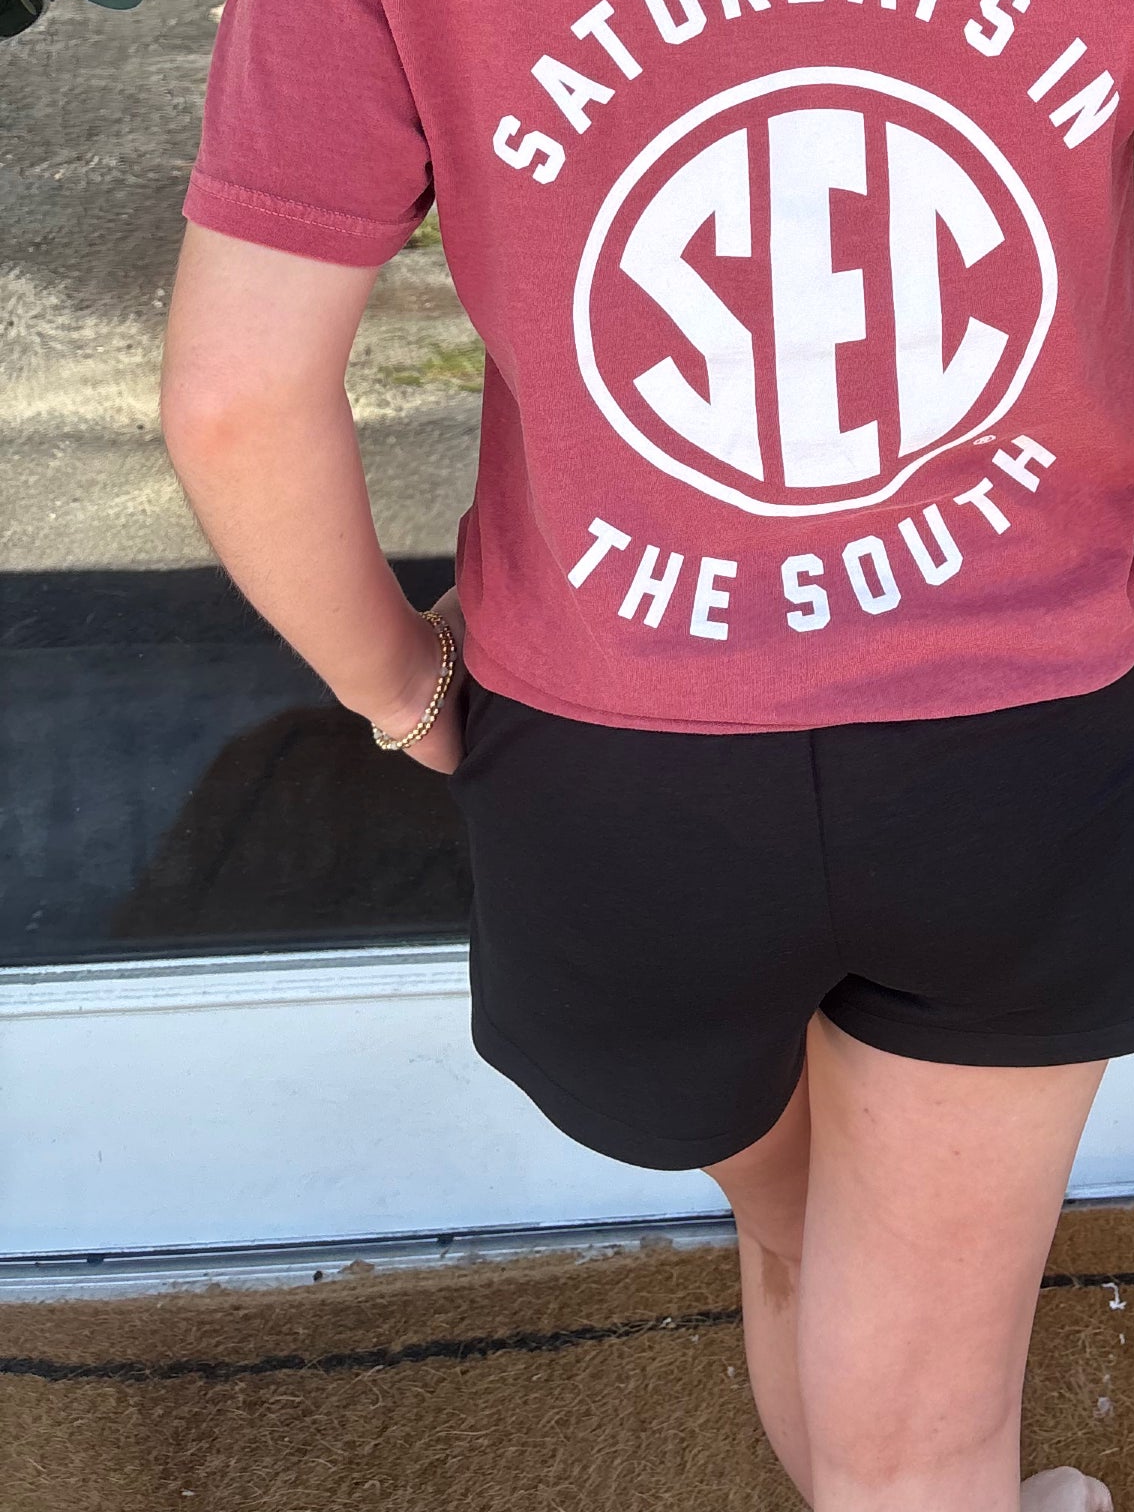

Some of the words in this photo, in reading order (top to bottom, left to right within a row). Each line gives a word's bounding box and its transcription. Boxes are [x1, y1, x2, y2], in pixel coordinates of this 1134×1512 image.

[1026, 37, 1121, 150] IN
[619, 108, 1010, 488] SEC
[567, 517, 738, 641] THE
[780, 434, 1057, 633] SOUTH
